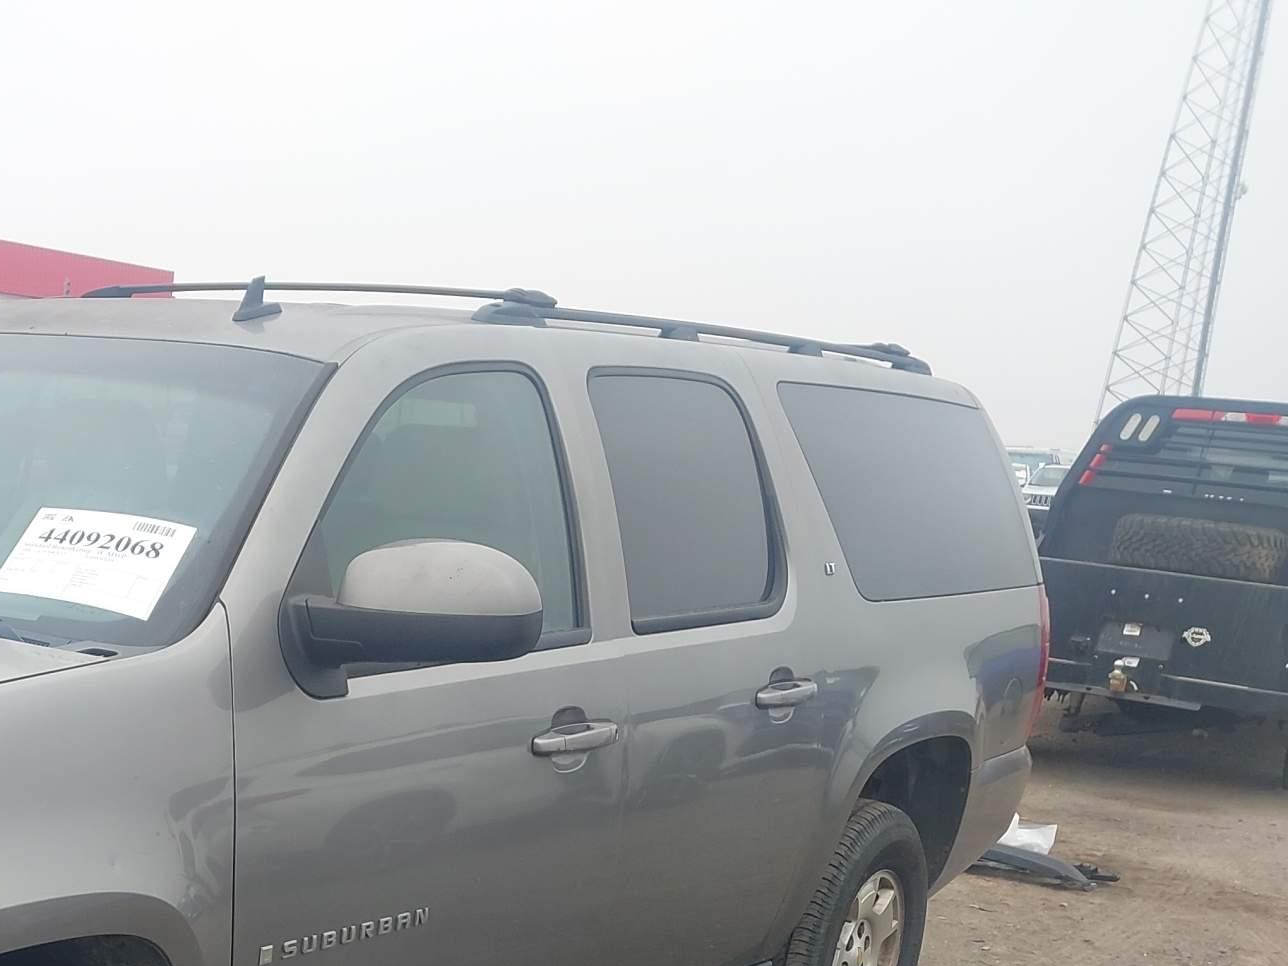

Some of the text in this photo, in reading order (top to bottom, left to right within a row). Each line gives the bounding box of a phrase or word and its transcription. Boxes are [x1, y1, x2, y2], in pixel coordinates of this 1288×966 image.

[38, 527, 164, 560] 44092068
[825, 562, 836, 576] LT
[281, 907, 431, 959] SUBURBAN
